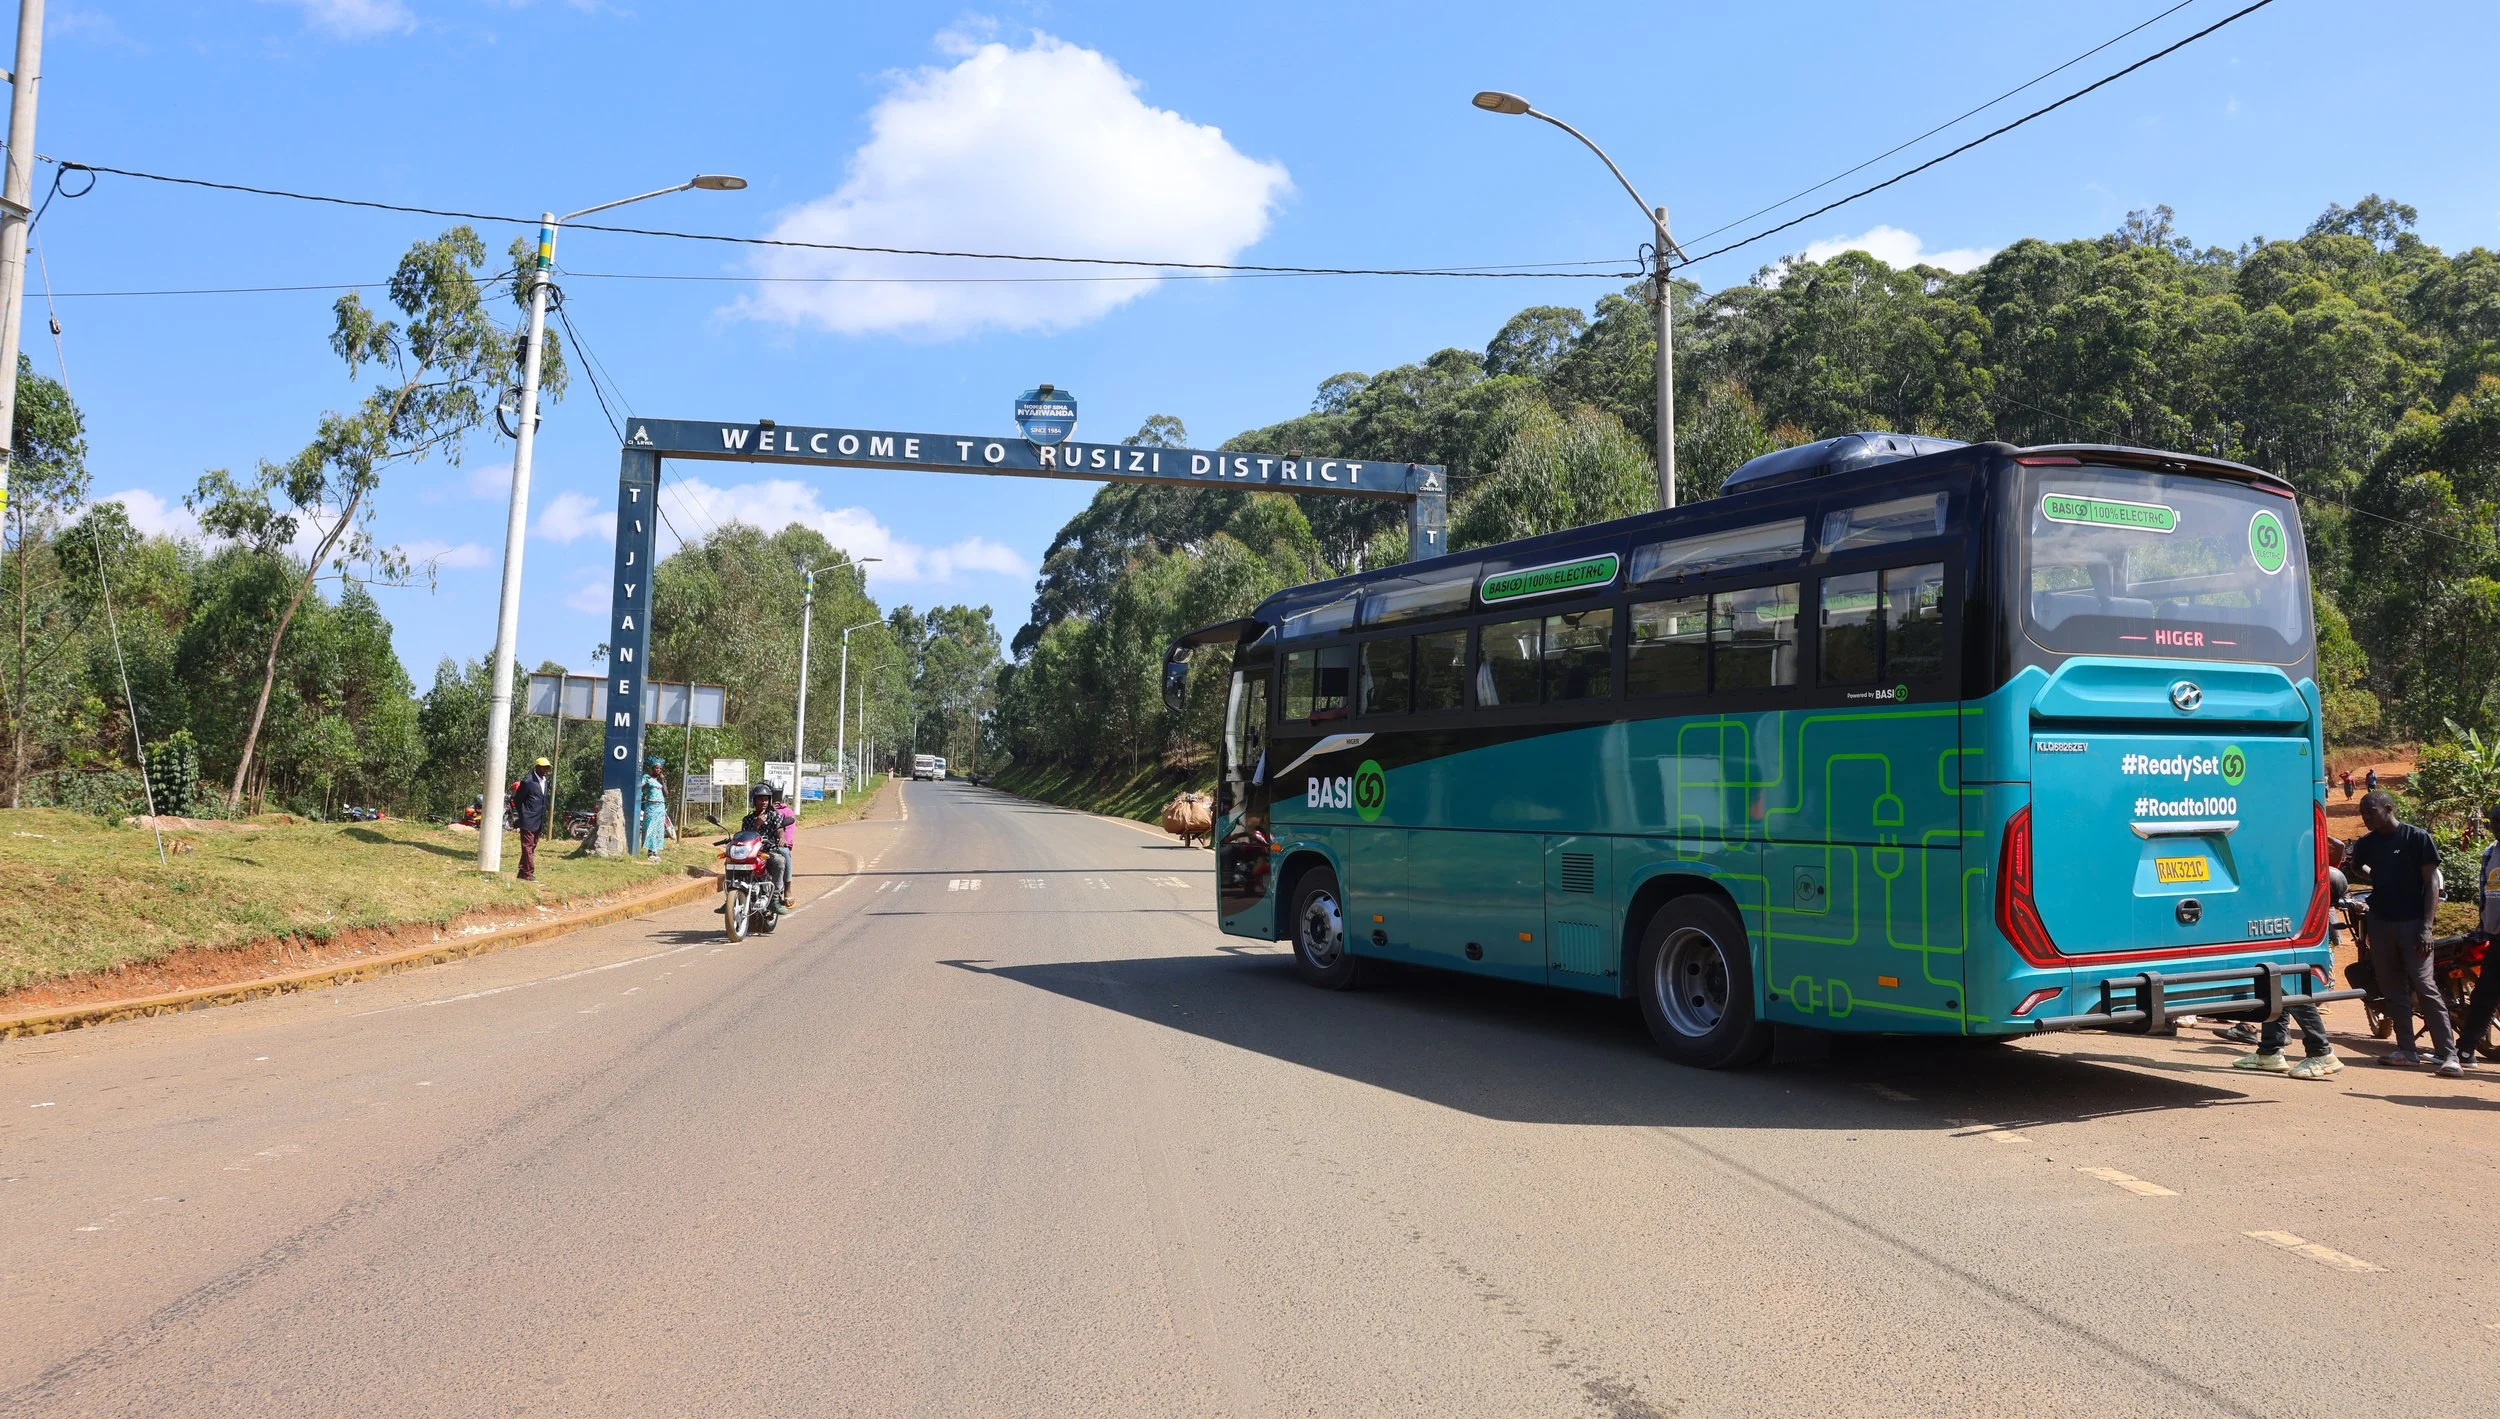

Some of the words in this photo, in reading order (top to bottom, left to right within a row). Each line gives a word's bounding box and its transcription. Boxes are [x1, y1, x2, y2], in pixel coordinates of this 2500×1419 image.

[1018, 409, 1074, 417] NYARWANDA
[722, 428, 919, 459] WELCOME
[957, 440, 1004, 463] TO
[1040, 446, 1158, 473] RUSIZI
[1191, 455, 1361, 484] DISTRICT
[2093, 506, 2118, 520] 100%
[1528, 573, 1552, 588] 100%
[2155, 630, 2204, 647] HIGER
[2036, 741, 2089, 752] KLQ6826ZEV
[2121, 754, 2219, 781] #ReadySet
[2134, 797, 2237, 817] #Roadto1000
[2158, 860, 2204, 879] RAK321C
[2248, 918, 2292, 937] HIGER
